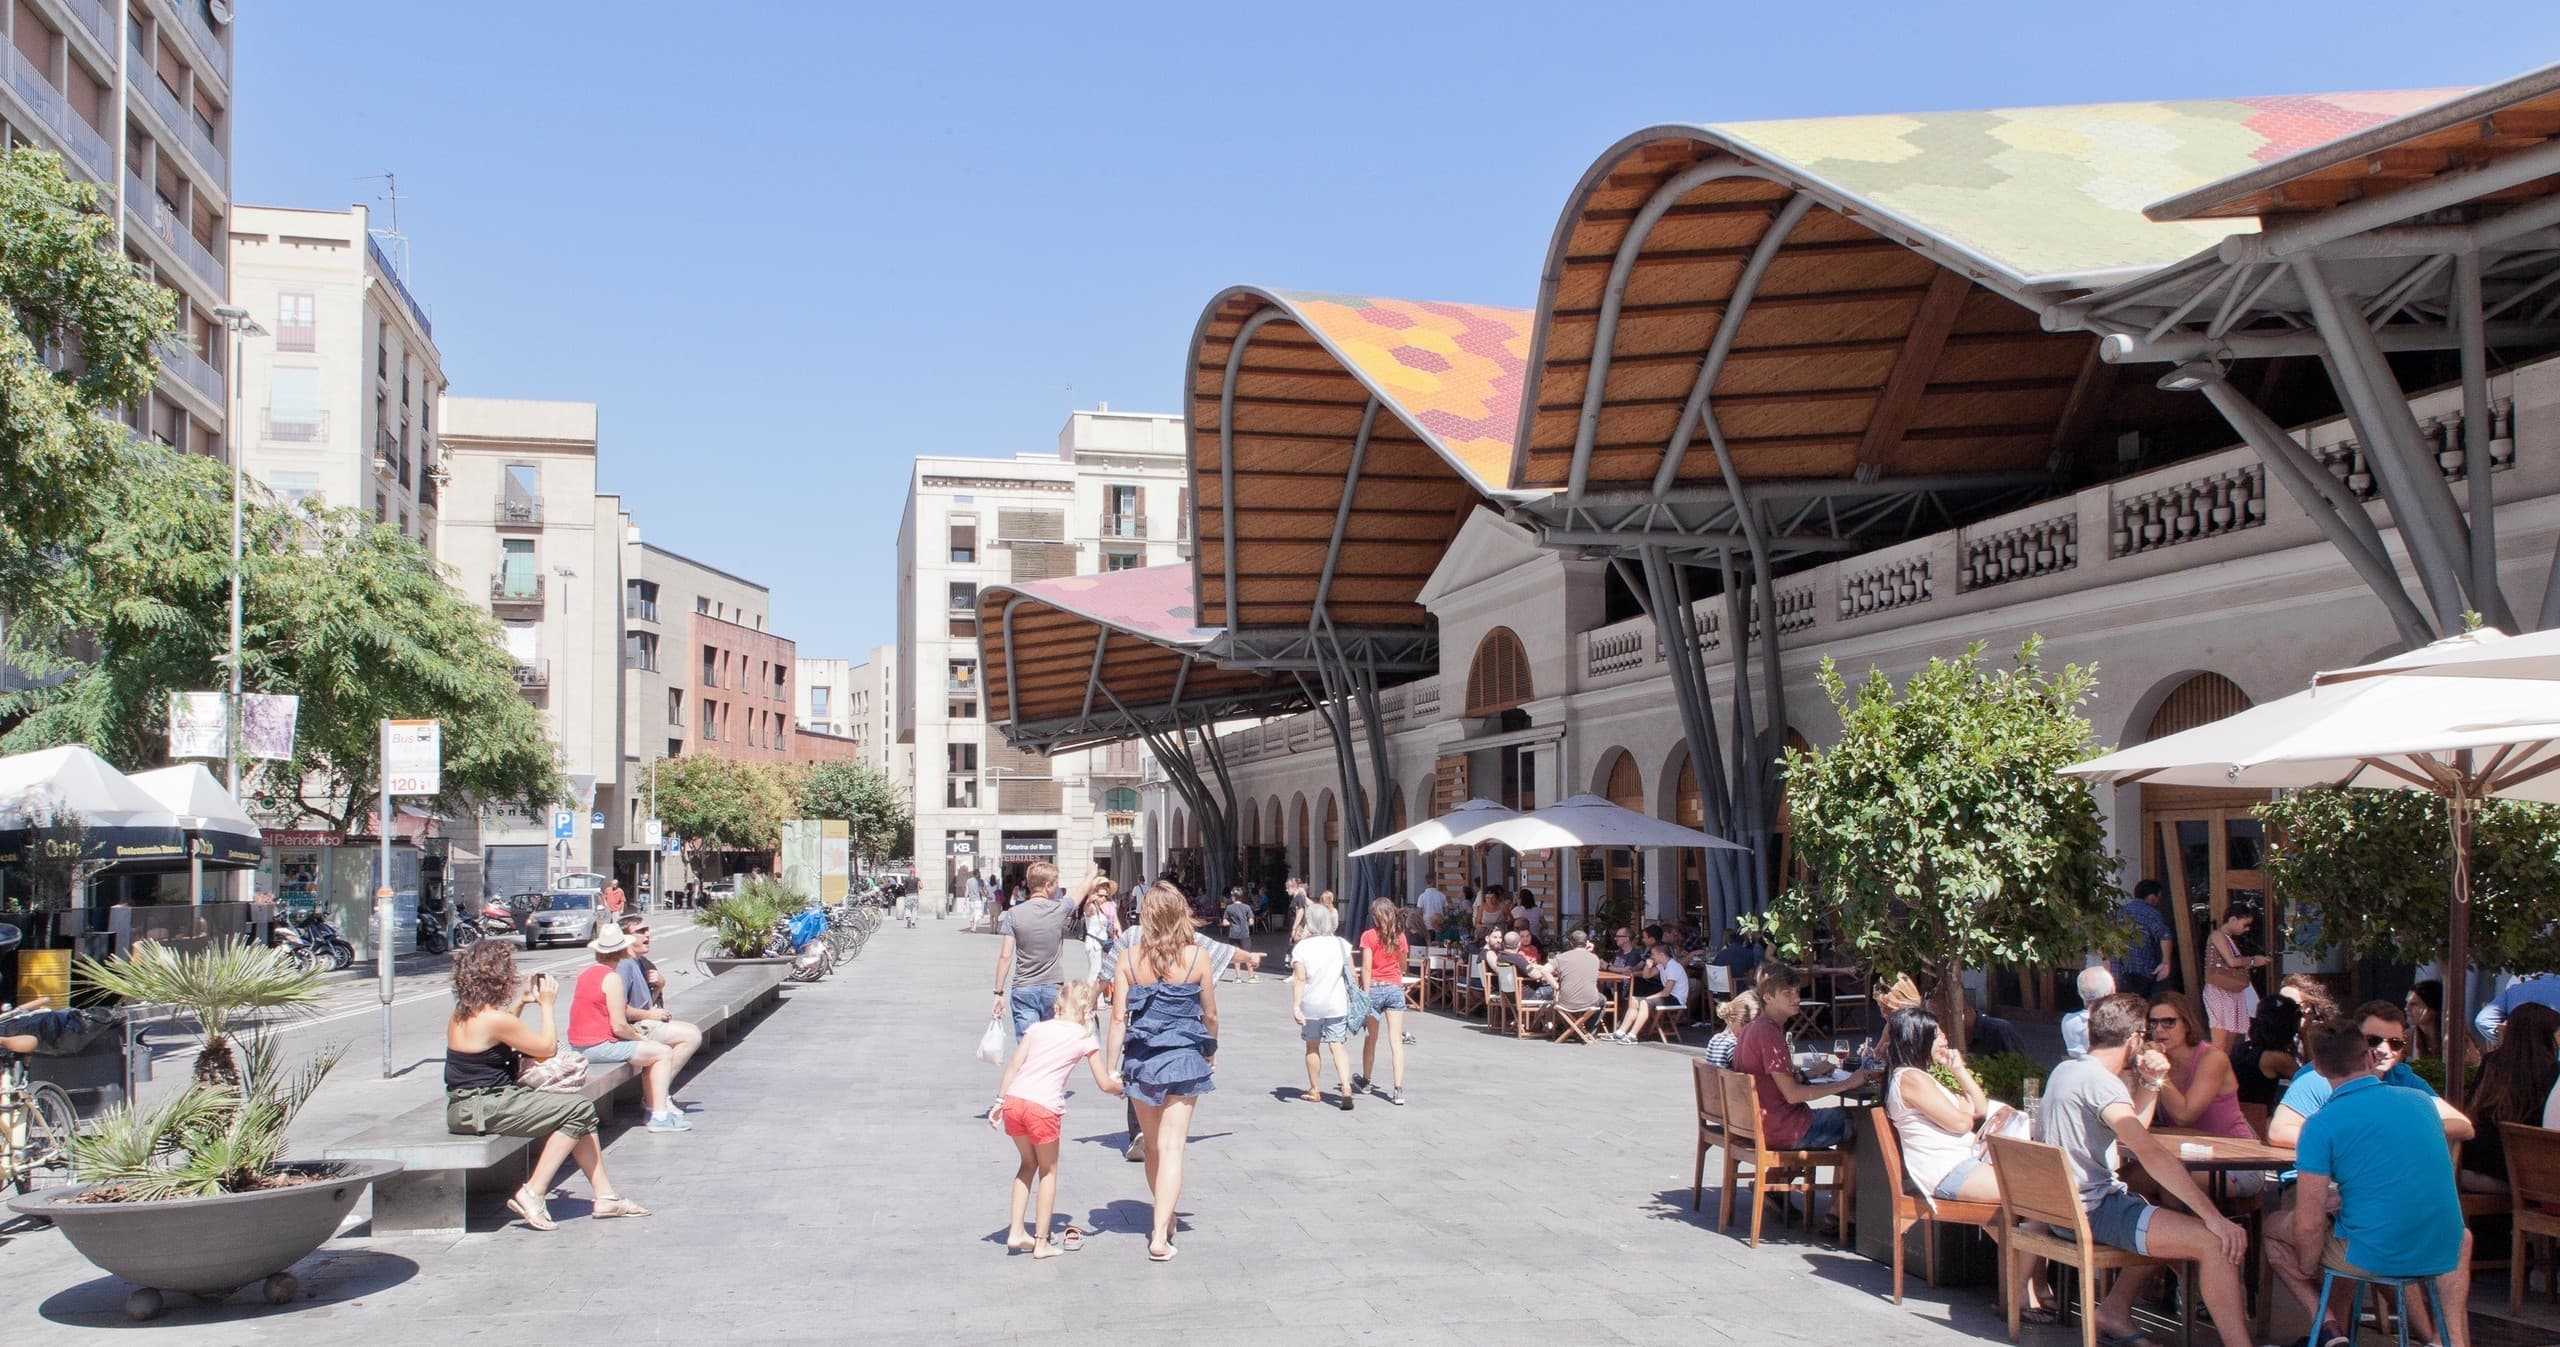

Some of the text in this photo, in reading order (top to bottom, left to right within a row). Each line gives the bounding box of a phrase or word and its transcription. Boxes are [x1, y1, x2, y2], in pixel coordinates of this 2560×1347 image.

[392, 733, 414, 743] Bus
[391, 778, 416, 791] 120
[558, 813, 571, 829] P
[274, 833, 341, 847] Periódico
[671, 840, 679, 850] P
